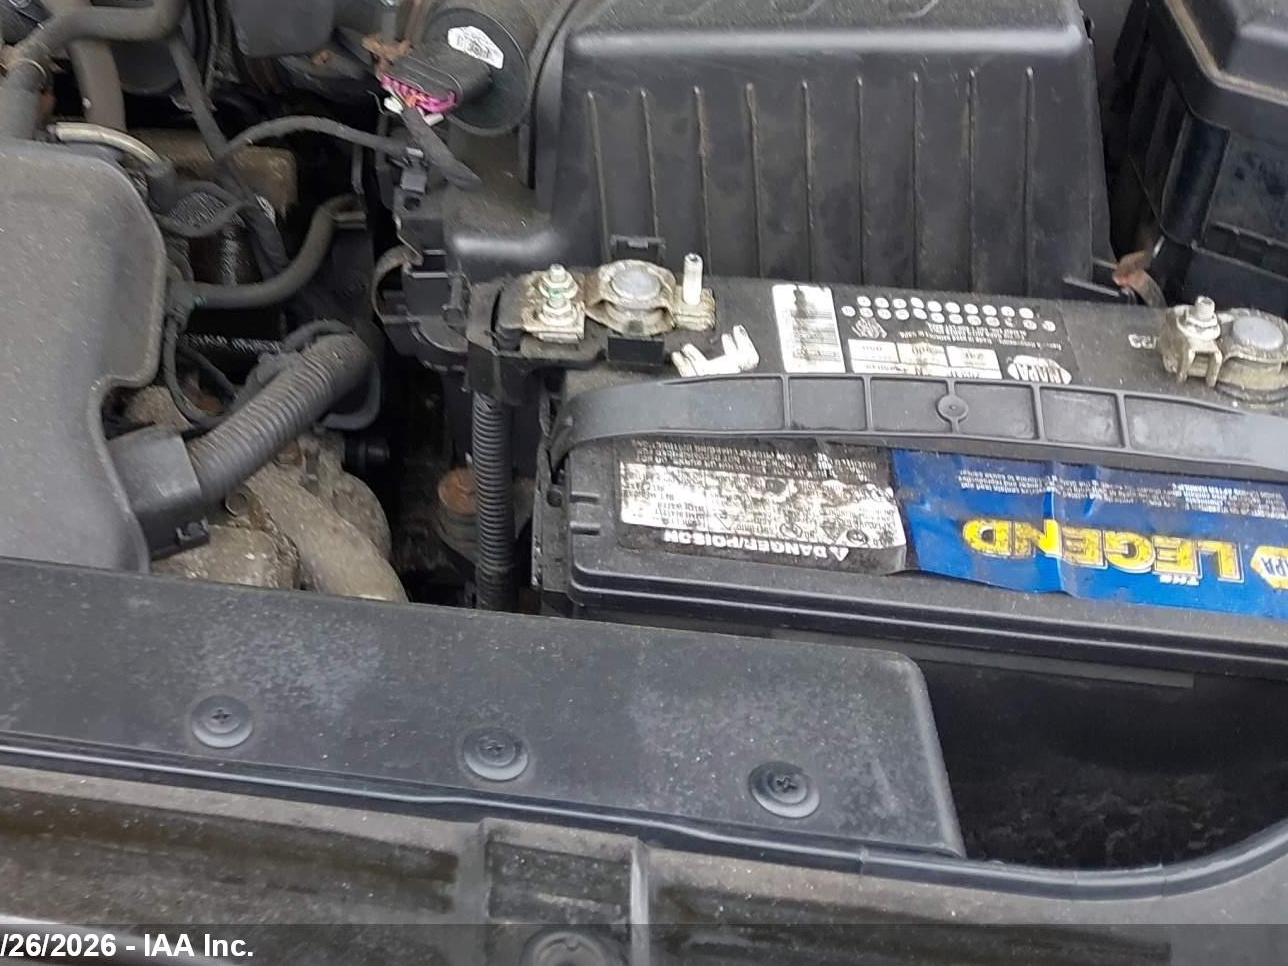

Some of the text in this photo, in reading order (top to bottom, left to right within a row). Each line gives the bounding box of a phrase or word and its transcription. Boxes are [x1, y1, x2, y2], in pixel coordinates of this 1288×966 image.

[663, 529, 828, 559] DANGER/POISON
[963, 519, 1244, 583] LEGEND
[1159, 575, 1200, 586] THE
